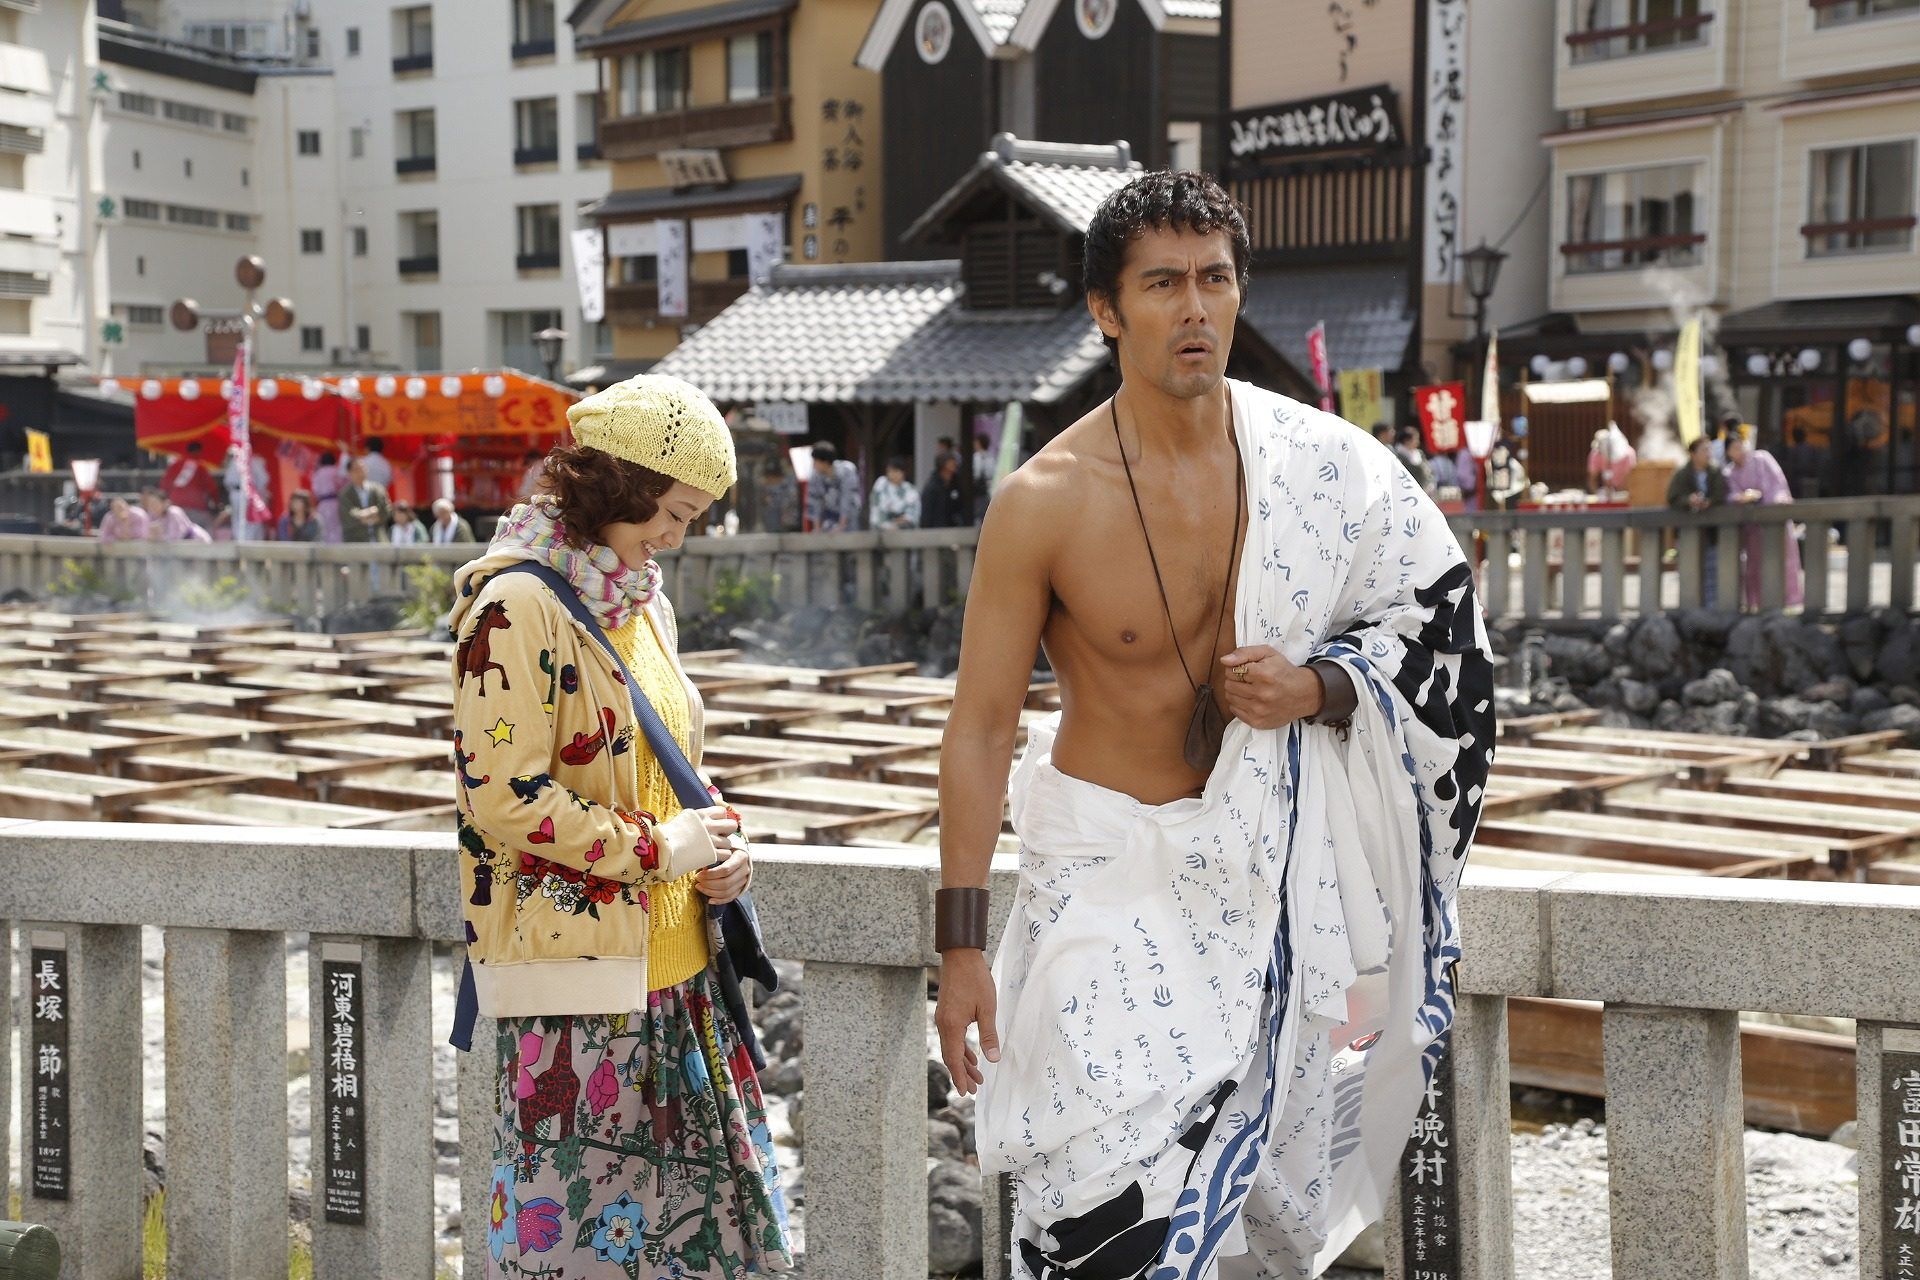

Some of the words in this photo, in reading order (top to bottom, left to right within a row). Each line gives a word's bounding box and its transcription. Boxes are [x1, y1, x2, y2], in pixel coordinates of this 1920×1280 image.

[330, 972, 358, 1098] 河東碧梧桐
[38, 1147, 61, 1157] 1897
[332, 1168, 356, 1179] 1921
[1432, 1195, 1447, 1247] 小説家
